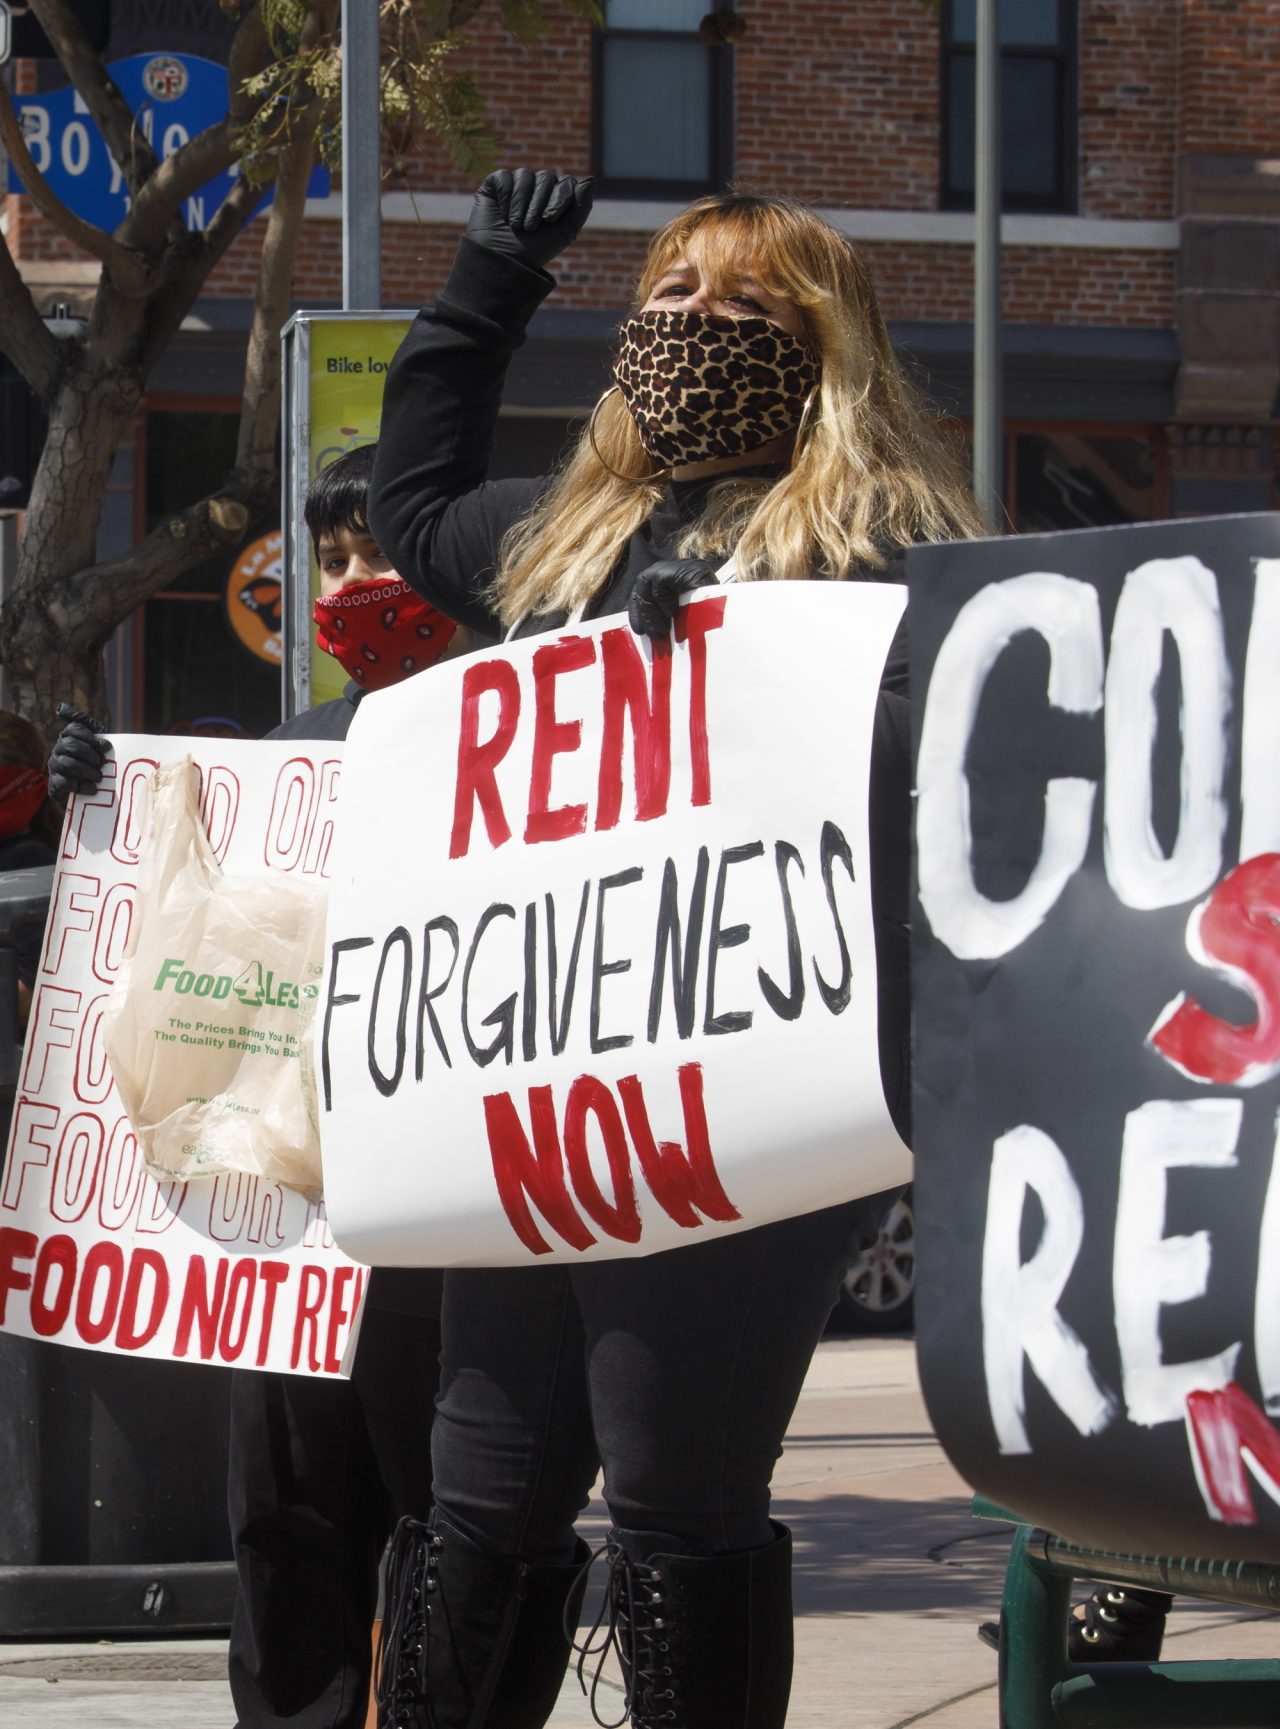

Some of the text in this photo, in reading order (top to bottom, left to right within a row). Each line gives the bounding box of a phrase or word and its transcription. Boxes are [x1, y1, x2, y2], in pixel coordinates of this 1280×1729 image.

[326, 356, 363, 373] Bike
[449, 594, 727, 860] RENT
[62, 757, 241, 867] FOD
[42, 871, 137, 985] FO
[321, 820, 856, 1112] FORGIVENESS
[22, 983, 115, 1105] FO
[154, 1030, 176, 1042] The
[180, 1034, 225, 1050] Quality
[228, 1039, 262, 1055] Brings
[264, 1044, 280, 1056] You
[169, 1018, 298, 1045] The Prices Bring You In.
[265, 970, 299, 1009] LES
[1, 1096, 189, 1234] FOOD
[483, 1060, 744, 1256] NOW
[172, 1254, 290, 1367] NOT
[981, 1098, 1280, 1454] RE
